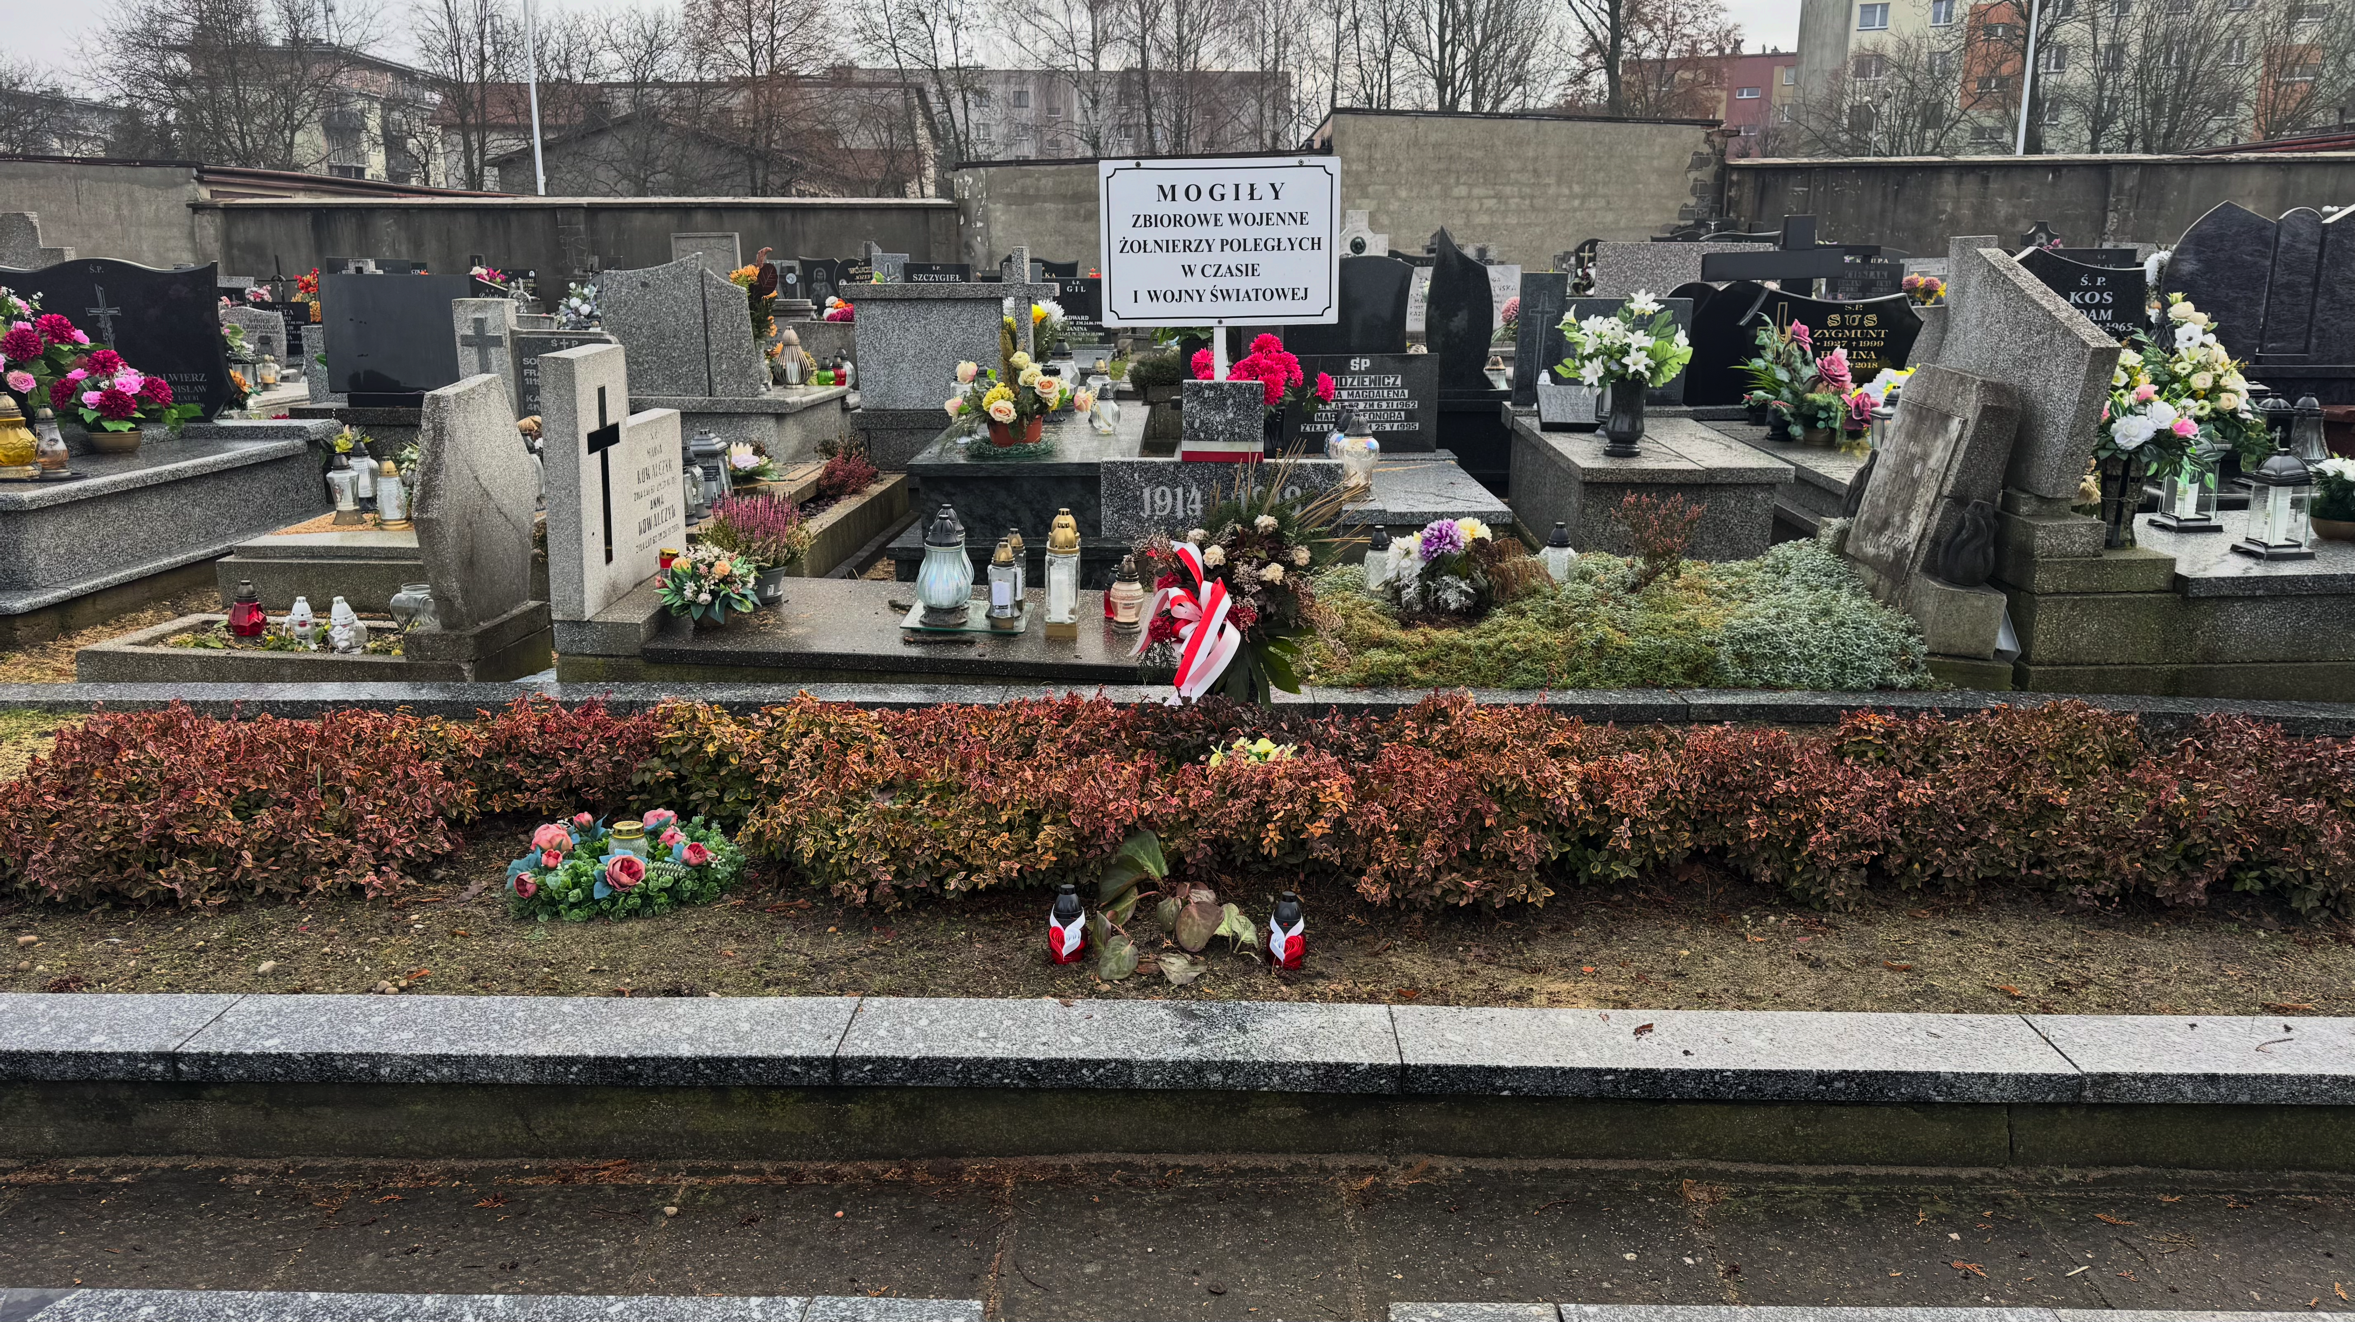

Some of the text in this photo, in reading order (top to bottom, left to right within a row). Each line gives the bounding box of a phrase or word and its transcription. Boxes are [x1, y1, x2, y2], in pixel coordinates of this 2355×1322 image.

[1156, 182, 1285, 202] MOGIŁY
[1132, 211, 1309, 228] ZBIOROWE WOJENNE
[1119, 236, 1322, 254] ŻOŁNIERZY POLEGŁYCH
[1181, 263, 1261, 278] W CZASIE
[912, 273, 962, 282] SZCZYGIEŁ
[2080, 273, 2106, 286] Ś. P.
[1133, 285, 1309, 303] I WOJNY ŚWIATOWEJ
[2069, 291, 2113, 304] KOS
[1826, 313, 1878, 327] SUS
[2079, 309, 2113, 320] DAM
[1813, 329, 1889, 338] ZYGMUNT
[1820, 350, 1877, 359] HLINA
[1855, 361, 1879, 369] 2018
[1331, 375, 1401, 387] ODZIEWICZ
[1347, 390, 1407, 399] MAGDALENA
[1396, 423, 1417, 431] 1995
[650, 494, 664, 510] ANNA
[1140, 484, 1203, 519] 1914
[638, 504, 676, 536] KOWALCZYK
